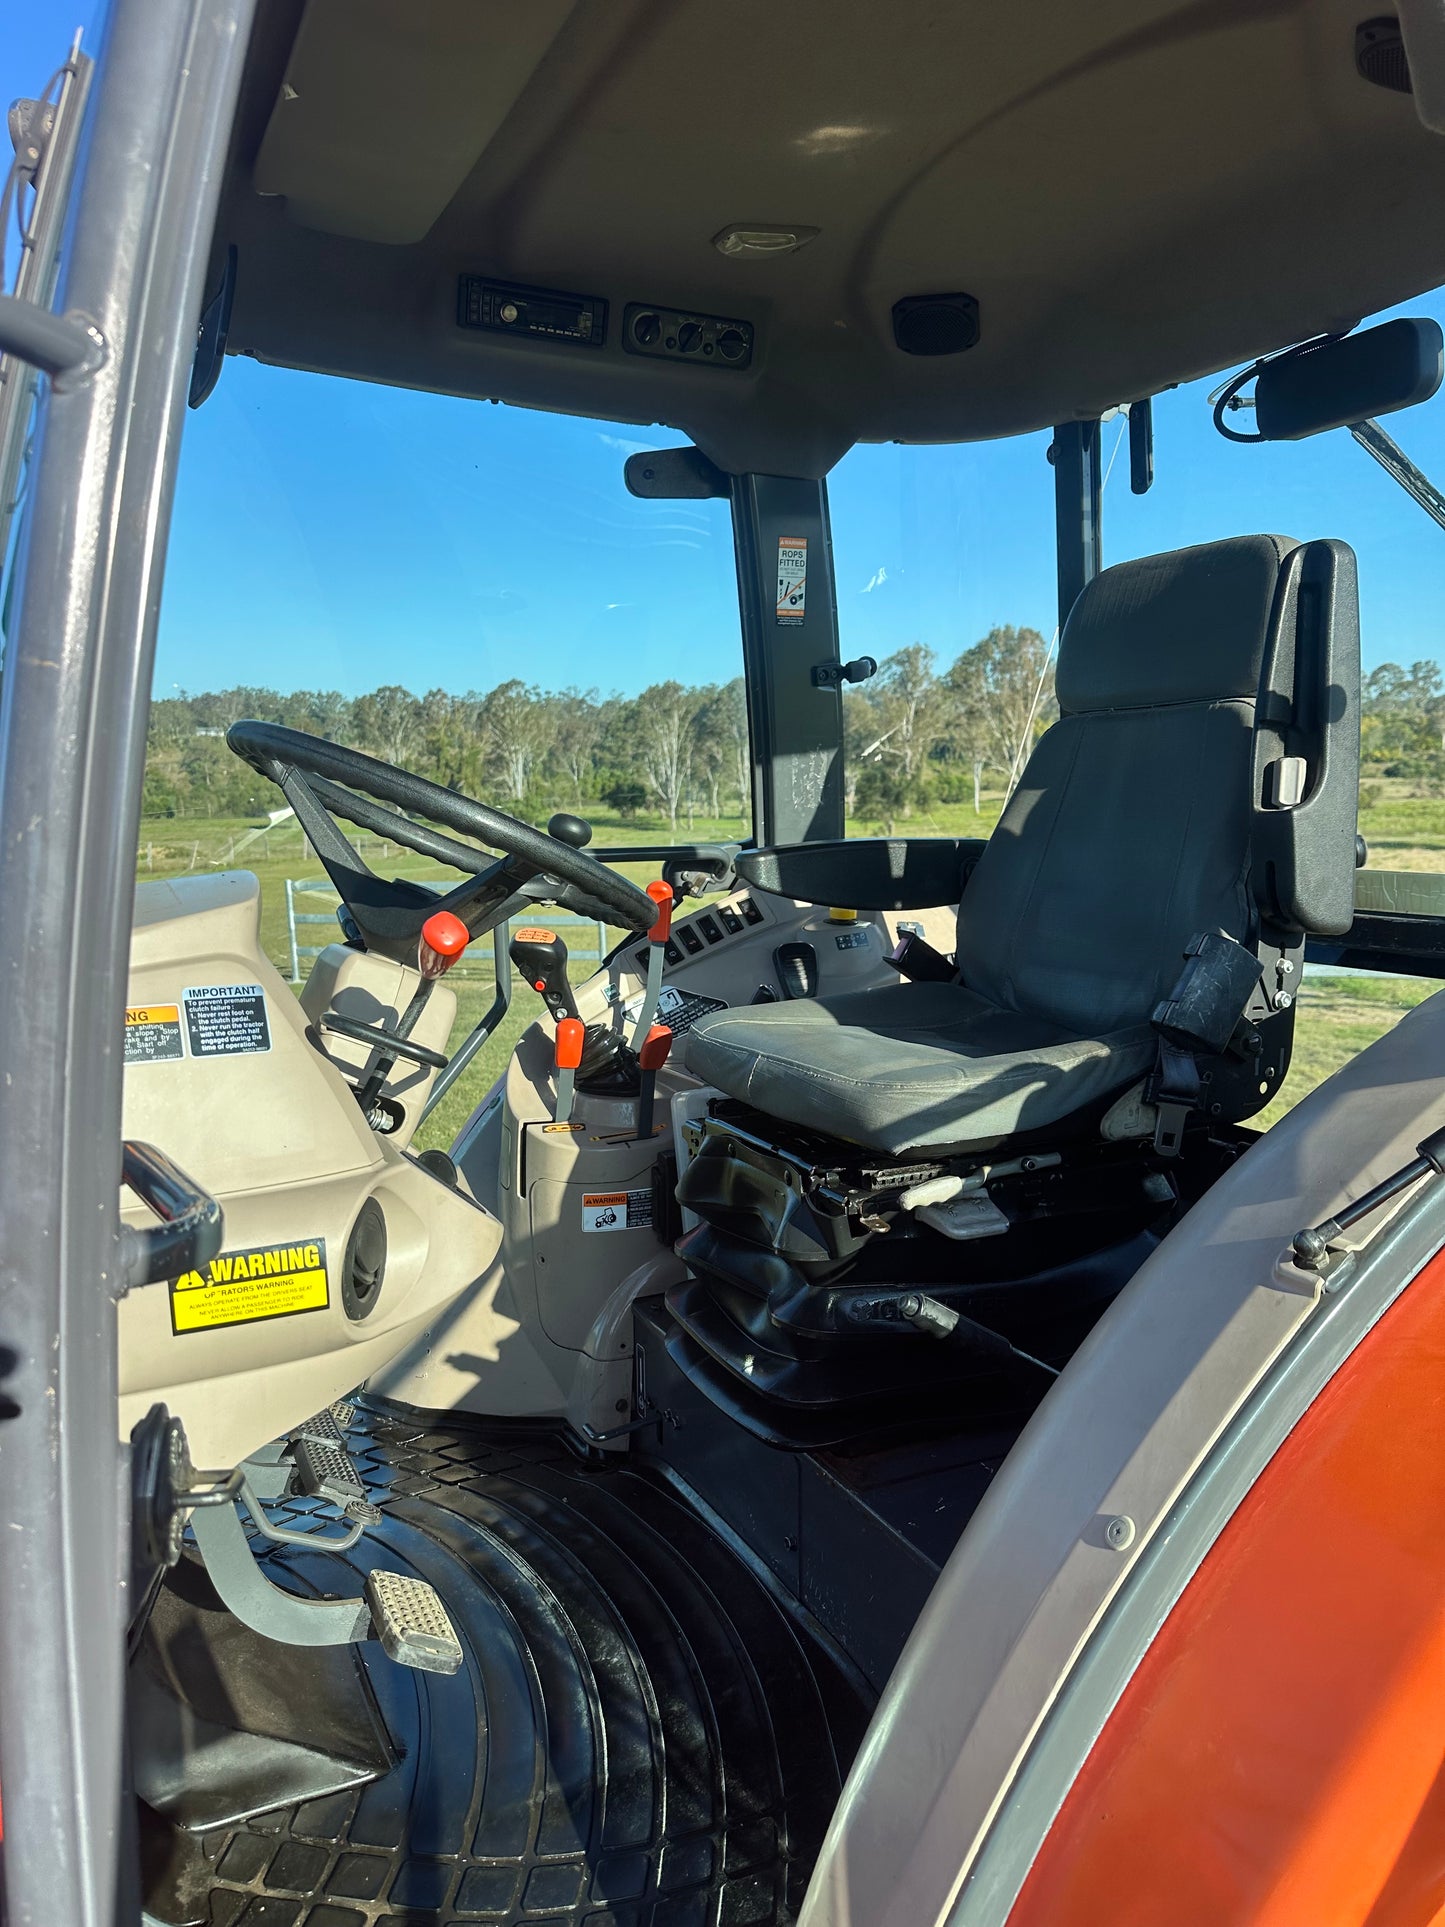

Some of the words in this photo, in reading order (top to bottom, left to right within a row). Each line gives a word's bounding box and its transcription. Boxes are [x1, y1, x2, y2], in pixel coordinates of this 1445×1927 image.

[782, 550, 803, 559] ROPS
[779, 559, 805, 567] FITTED
[188, 986, 256, 998] IMPORTANT
[126, 1011, 148, 1022] NG
[200, 1037, 229, 1045] engaged
[225, 1042, 258, 1050] operation.
[592, 1196, 626, 1204] WARNING
[209, 1244, 320, 1283] WARNING
[204, 1285, 254, 1299] OPRATORS
[256, 1279, 294, 1290] WARNING
[189, 1301, 213, 1310] ALWAYS
[213, 1297, 240, 1306] OPERATE
[272, 1288, 298, 1297] DRIVERS
[200, 1308, 220, 1316] NEVER
[247, 1298, 281, 1308] PASSENGER
[210, 1310, 243, 1320] ANYWHERE
[269, 1302, 294, 1310] MACHINE
